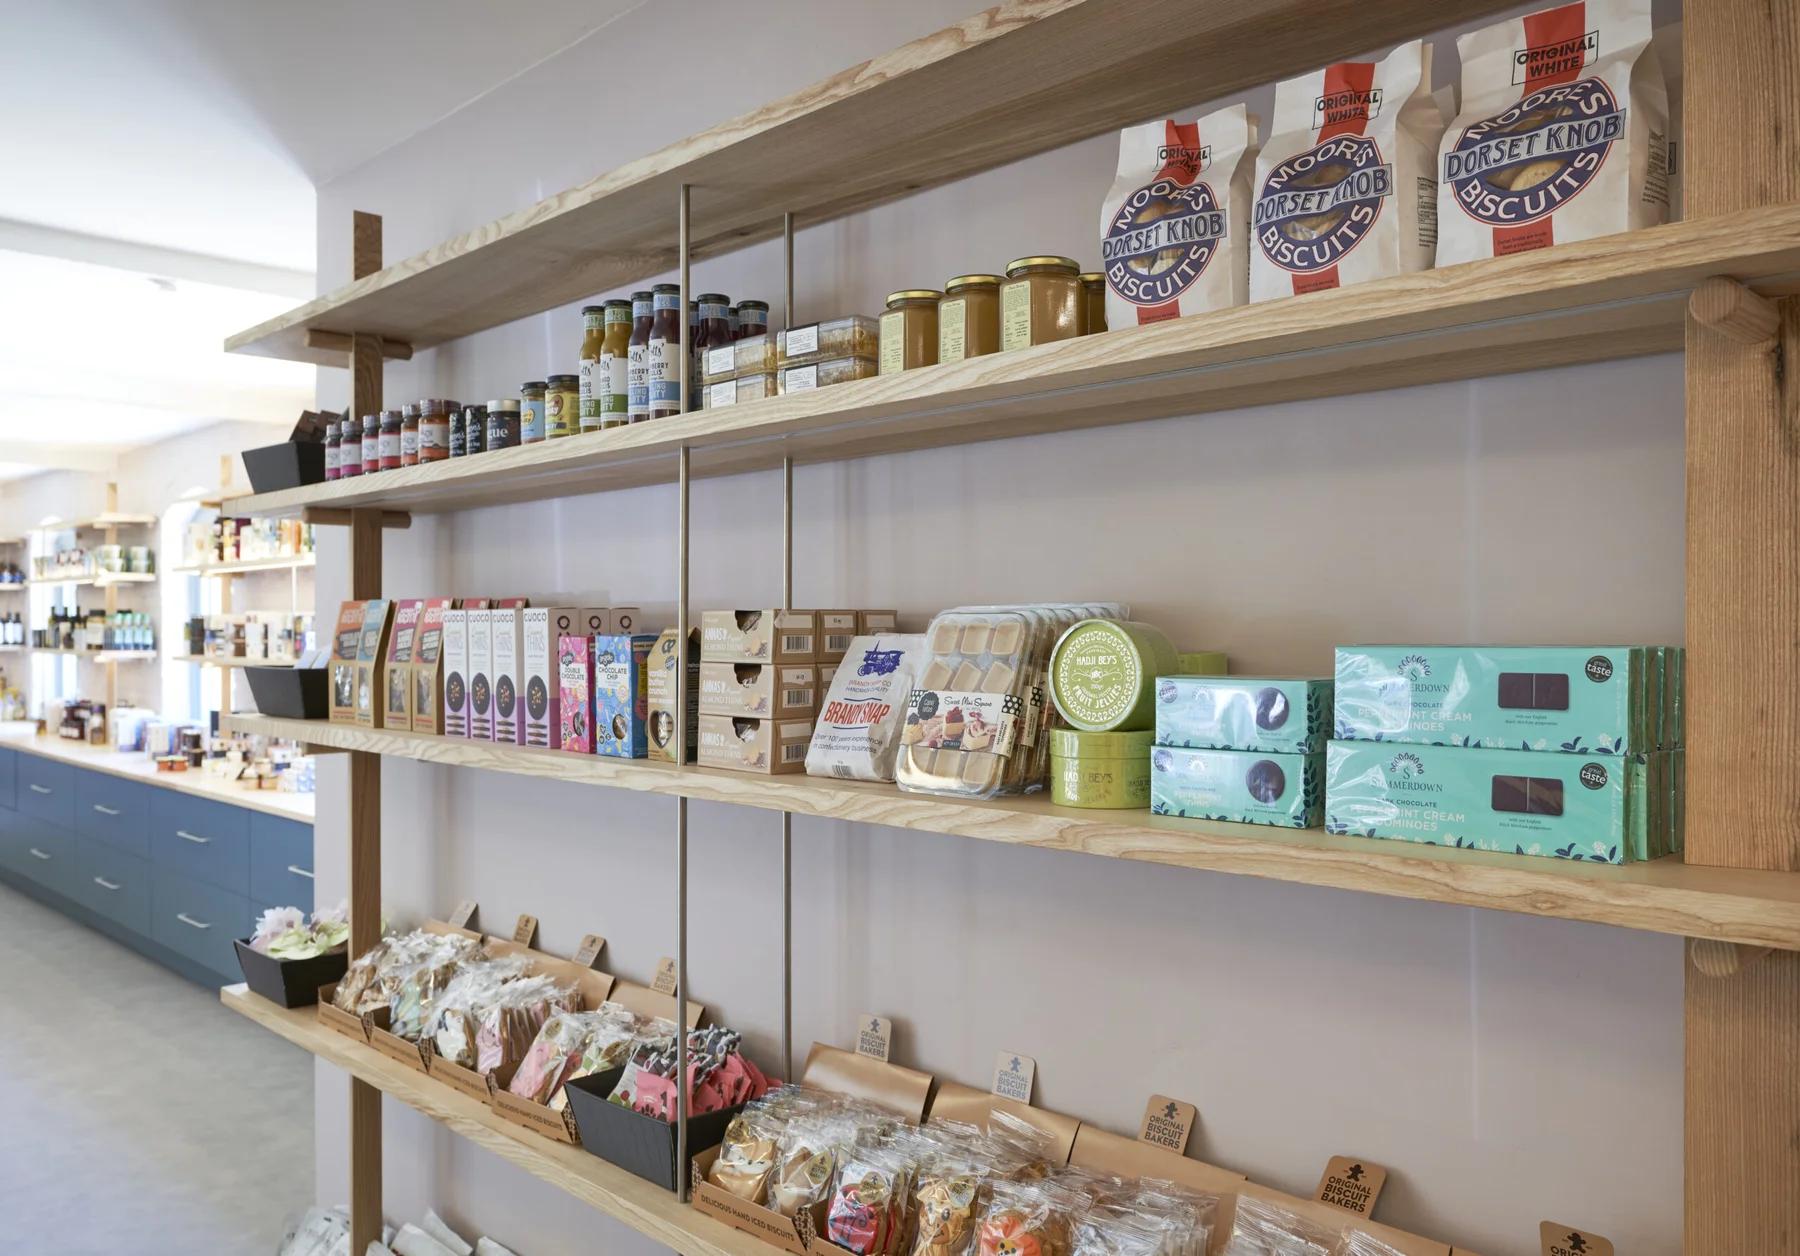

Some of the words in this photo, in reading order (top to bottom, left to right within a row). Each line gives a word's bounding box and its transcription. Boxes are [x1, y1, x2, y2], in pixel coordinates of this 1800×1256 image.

[1516, 36, 1595, 65] ORIGINAL
[1530, 55, 1580, 77] WHITE
[1159, 148, 1208, 161] ORIGNAL
[1446, 133, 1541, 180] DORSET
[1546, 114, 1621, 153] KNOB
[1461, 151, 1599, 219] BISCUITS
[1255, 190, 1330, 226] DORSET
[1103, 223, 1162, 259] DORSET
[1167, 213, 1224, 247] KNOB
[1261, 204, 1374, 267] BISCUITS
[1109, 245, 1209, 300] BISCUITS
[524, 612, 547, 622] CUOCO
[1077, 656, 1097, 666] HADJI
[561, 673, 585, 681] CHOCOLATE
[598, 667, 627, 675] CHOCOLATE
[1587, 663, 1611, 677] taste
[1073, 685, 1093, 707] FRUIT
[1095, 684, 1121, 709] JELLIES
[1403, 701, 1444, 709] OCOLATE
[1430, 711, 1472, 721] CREAM
[1382, 720, 1445, 732] MINOES
[1581, 769, 1606, 785] taste
[1396, 799, 1438, 808] CHOCOLATE
[1423, 810, 1465, 823] CREAM
[861, 1037, 886, 1049] BISCUIT
[860, 1045, 884, 1058] BAKERS
[998, 1077, 1027, 1091] BISCUIT
[997, 1085, 1026, 1100] BAKERS
[1147, 1122, 1183, 1140] BISCUIT
[1149, 1115, 1185, 1132] ORIGINAL
[1144, 1131, 1181, 1149] BAKERS
[1328, 1175, 1372, 1195] ORIGINAL
[1324, 1183, 1370, 1204] BISCUIT
[1320, 1192, 1366, 1213] BAKERS
[701, 1194, 731, 1214] DELICIOUS
[732, 1208, 750, 1222] HAND
[751, 1216, 766, 1229] ICED
[766, 1223, 795, 1241] BISCUITS
